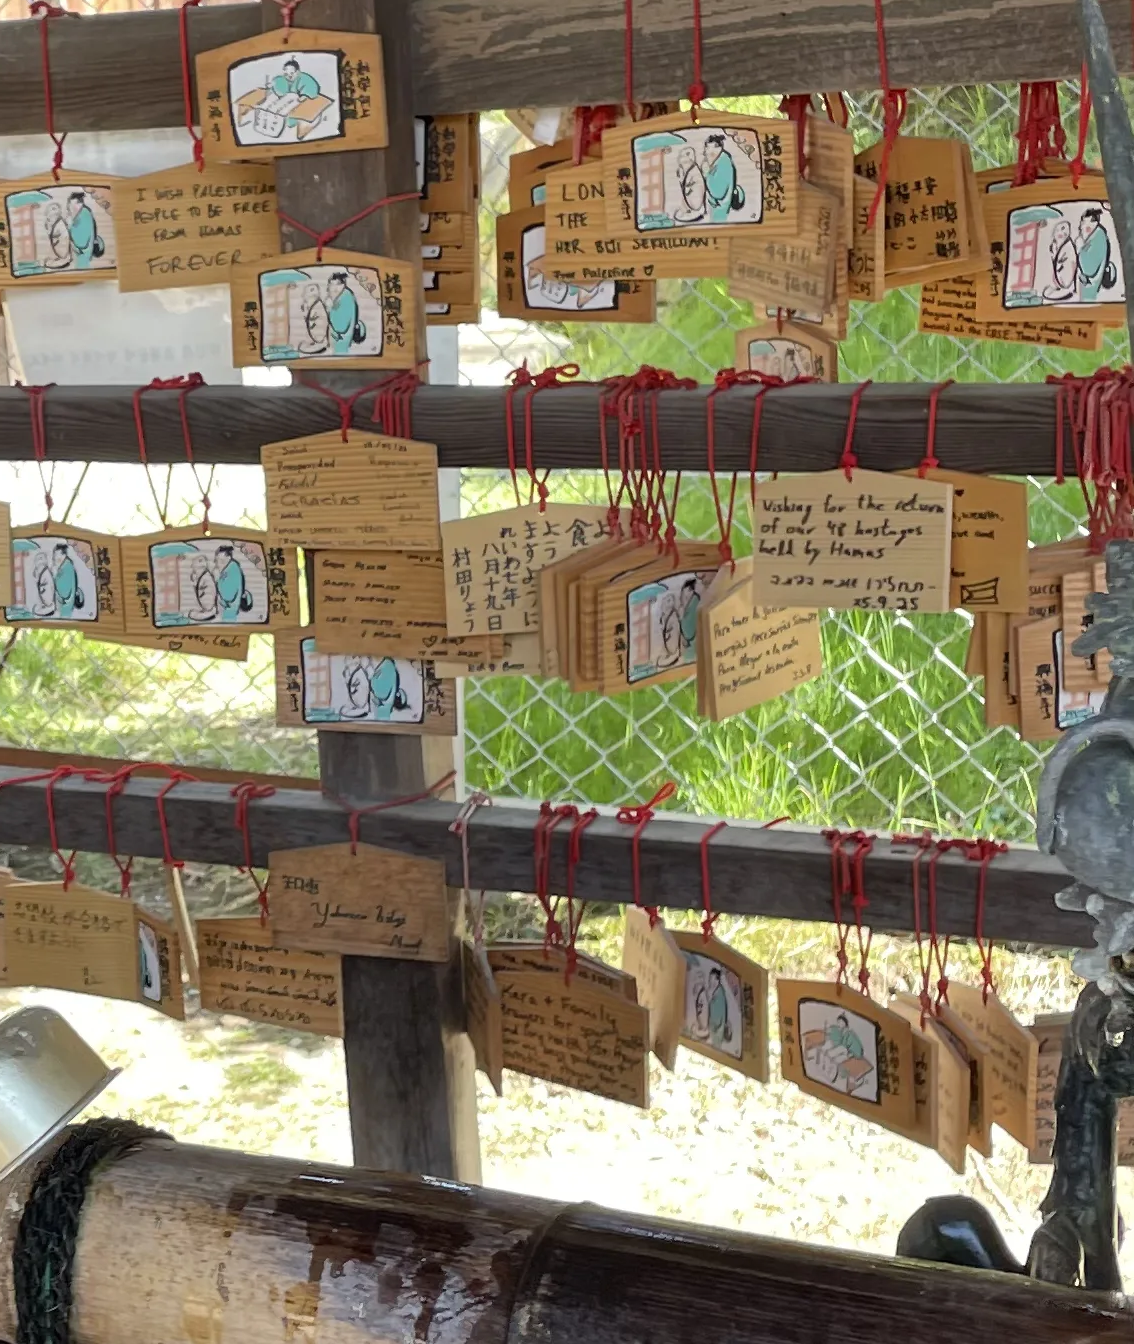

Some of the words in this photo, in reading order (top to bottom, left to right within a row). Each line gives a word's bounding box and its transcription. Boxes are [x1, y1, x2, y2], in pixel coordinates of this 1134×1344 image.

[133, 208, 179, 224] PEOPLE
[186, 206, 201, 218] TO
[207, 204, 223, 219] BE
[232, 200, 272, 214] FREE
[556, 212, 588, 229] THE
[153, 228, 187, 243] FROM
[198, 225, 242, 239] HAMAS
[146, 249, 242, 275] FOREVER
[582, 266, 635, 279] Palestine
[824, 494, 845, 514] for
[858, 494, 884, 512] the
[895, 493, 945, 513] return
[761, 517, 780, 535] of
[786, 525, 818, 536] our
[827, 520, 847, 537] 48
[855, 519, 923, 546] hostages
[804, 539, 821, 566] by
[830, 541, 885, 559] Hamas
